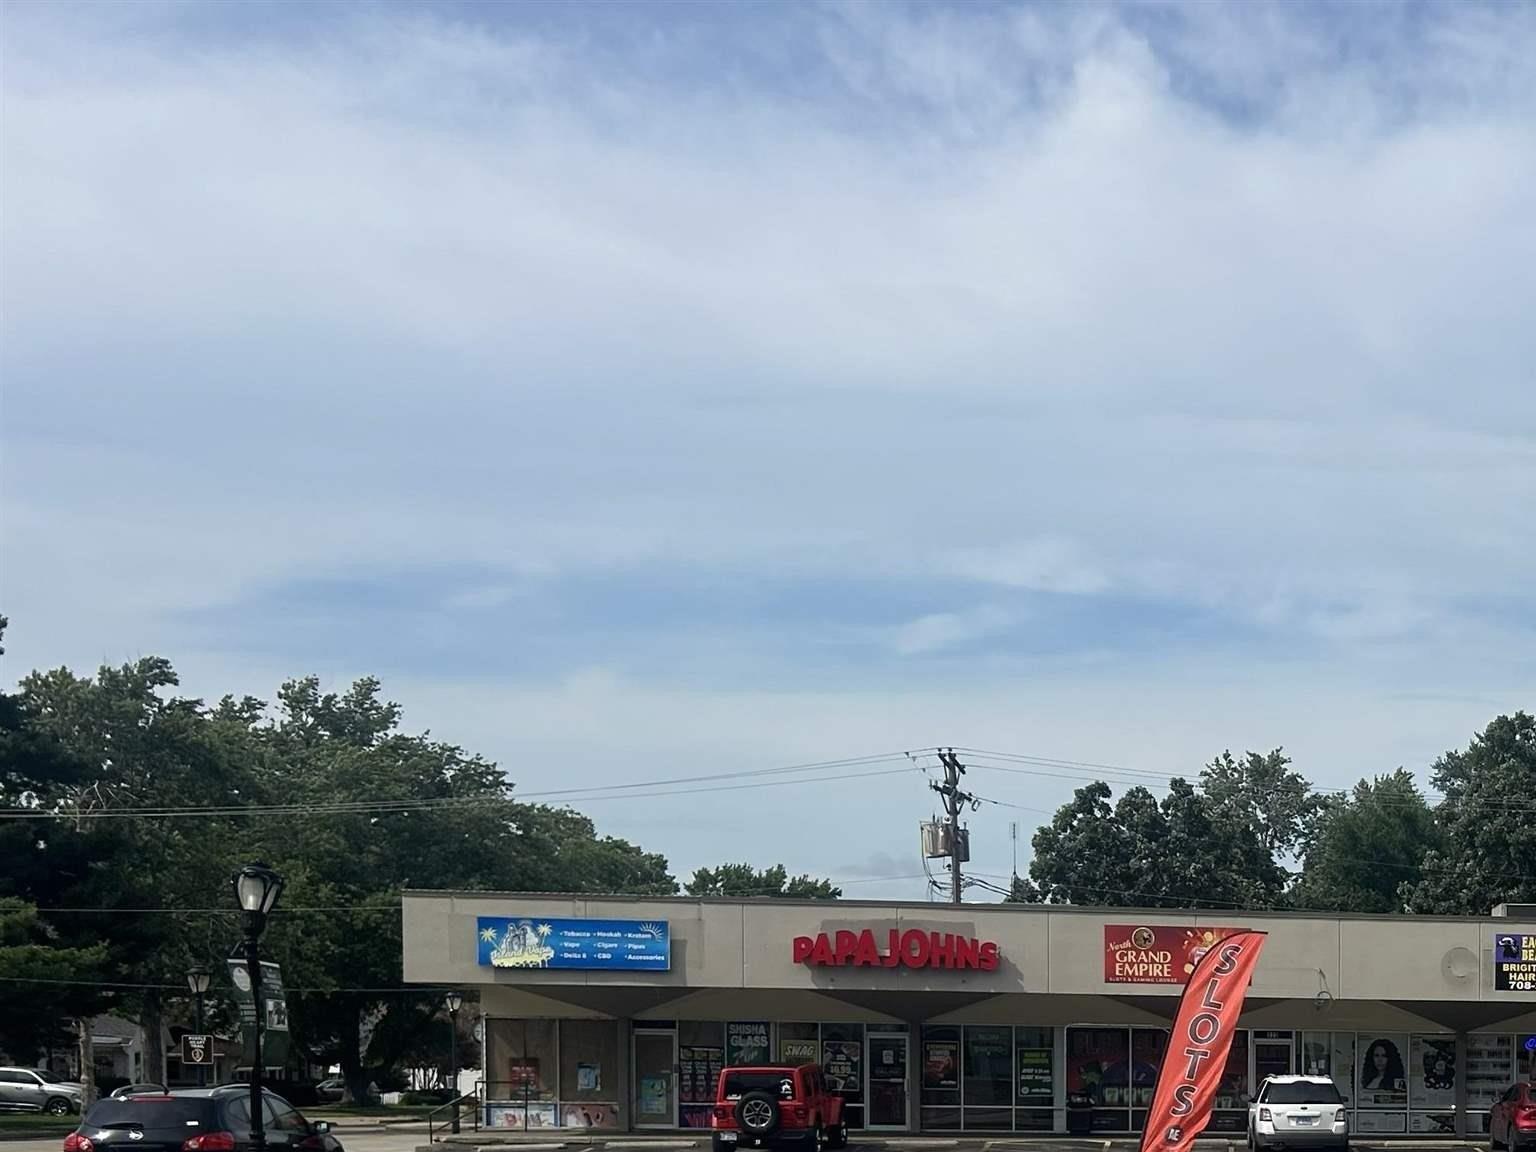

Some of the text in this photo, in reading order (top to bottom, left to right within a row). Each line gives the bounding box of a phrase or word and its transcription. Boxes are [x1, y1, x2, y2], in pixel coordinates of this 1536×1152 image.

[627, 943, 646, 951] Pipes
[793, 929, 999, 971] PAPA JOHNS
[1107, 939, 1132, 953] North
[1115, 950, 1171, 964] GRAND
[1115, 963, 1172, 977] EMPIRE
[1509, 973, 1536, 981] HAIR
[729, 1024, 766, 1035] SHISHA
[1170, 943, 1243, 1118] SLOTS
[731, 1035, 768, 1047] GLASS
[785, 1045, 814, 1056] SWAG
